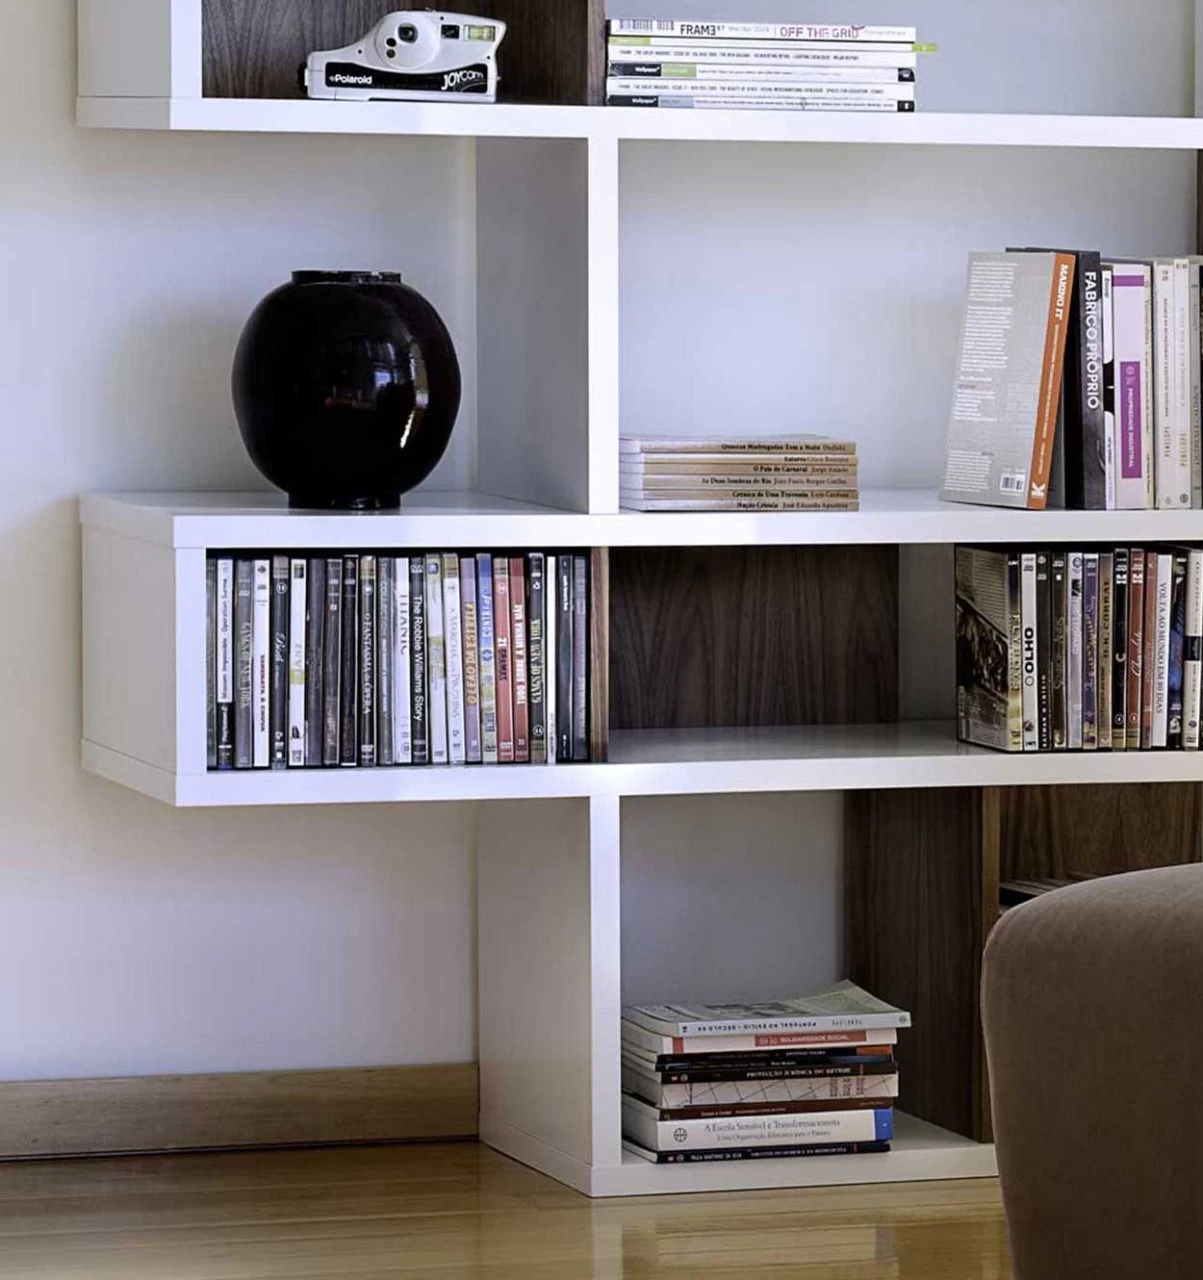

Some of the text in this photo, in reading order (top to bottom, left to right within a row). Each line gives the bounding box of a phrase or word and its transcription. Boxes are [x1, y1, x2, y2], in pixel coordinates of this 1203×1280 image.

[335, 75, 372, 84] Polaroid
[1084, 271, 1098, 340] FABRICO
[1159, 583, 1167, 614] VOLTA
[1158, 616, 1166, 629] AO
[413, 595, 424, 721] The Robbie Williams Story
[1024, 627, 1034, 674] OLHO
[1158, 630, 1166, 664] MUNDO
[1157, 666, 1165, 680] EM
[1156, 692, 1164, 714] DIAS
